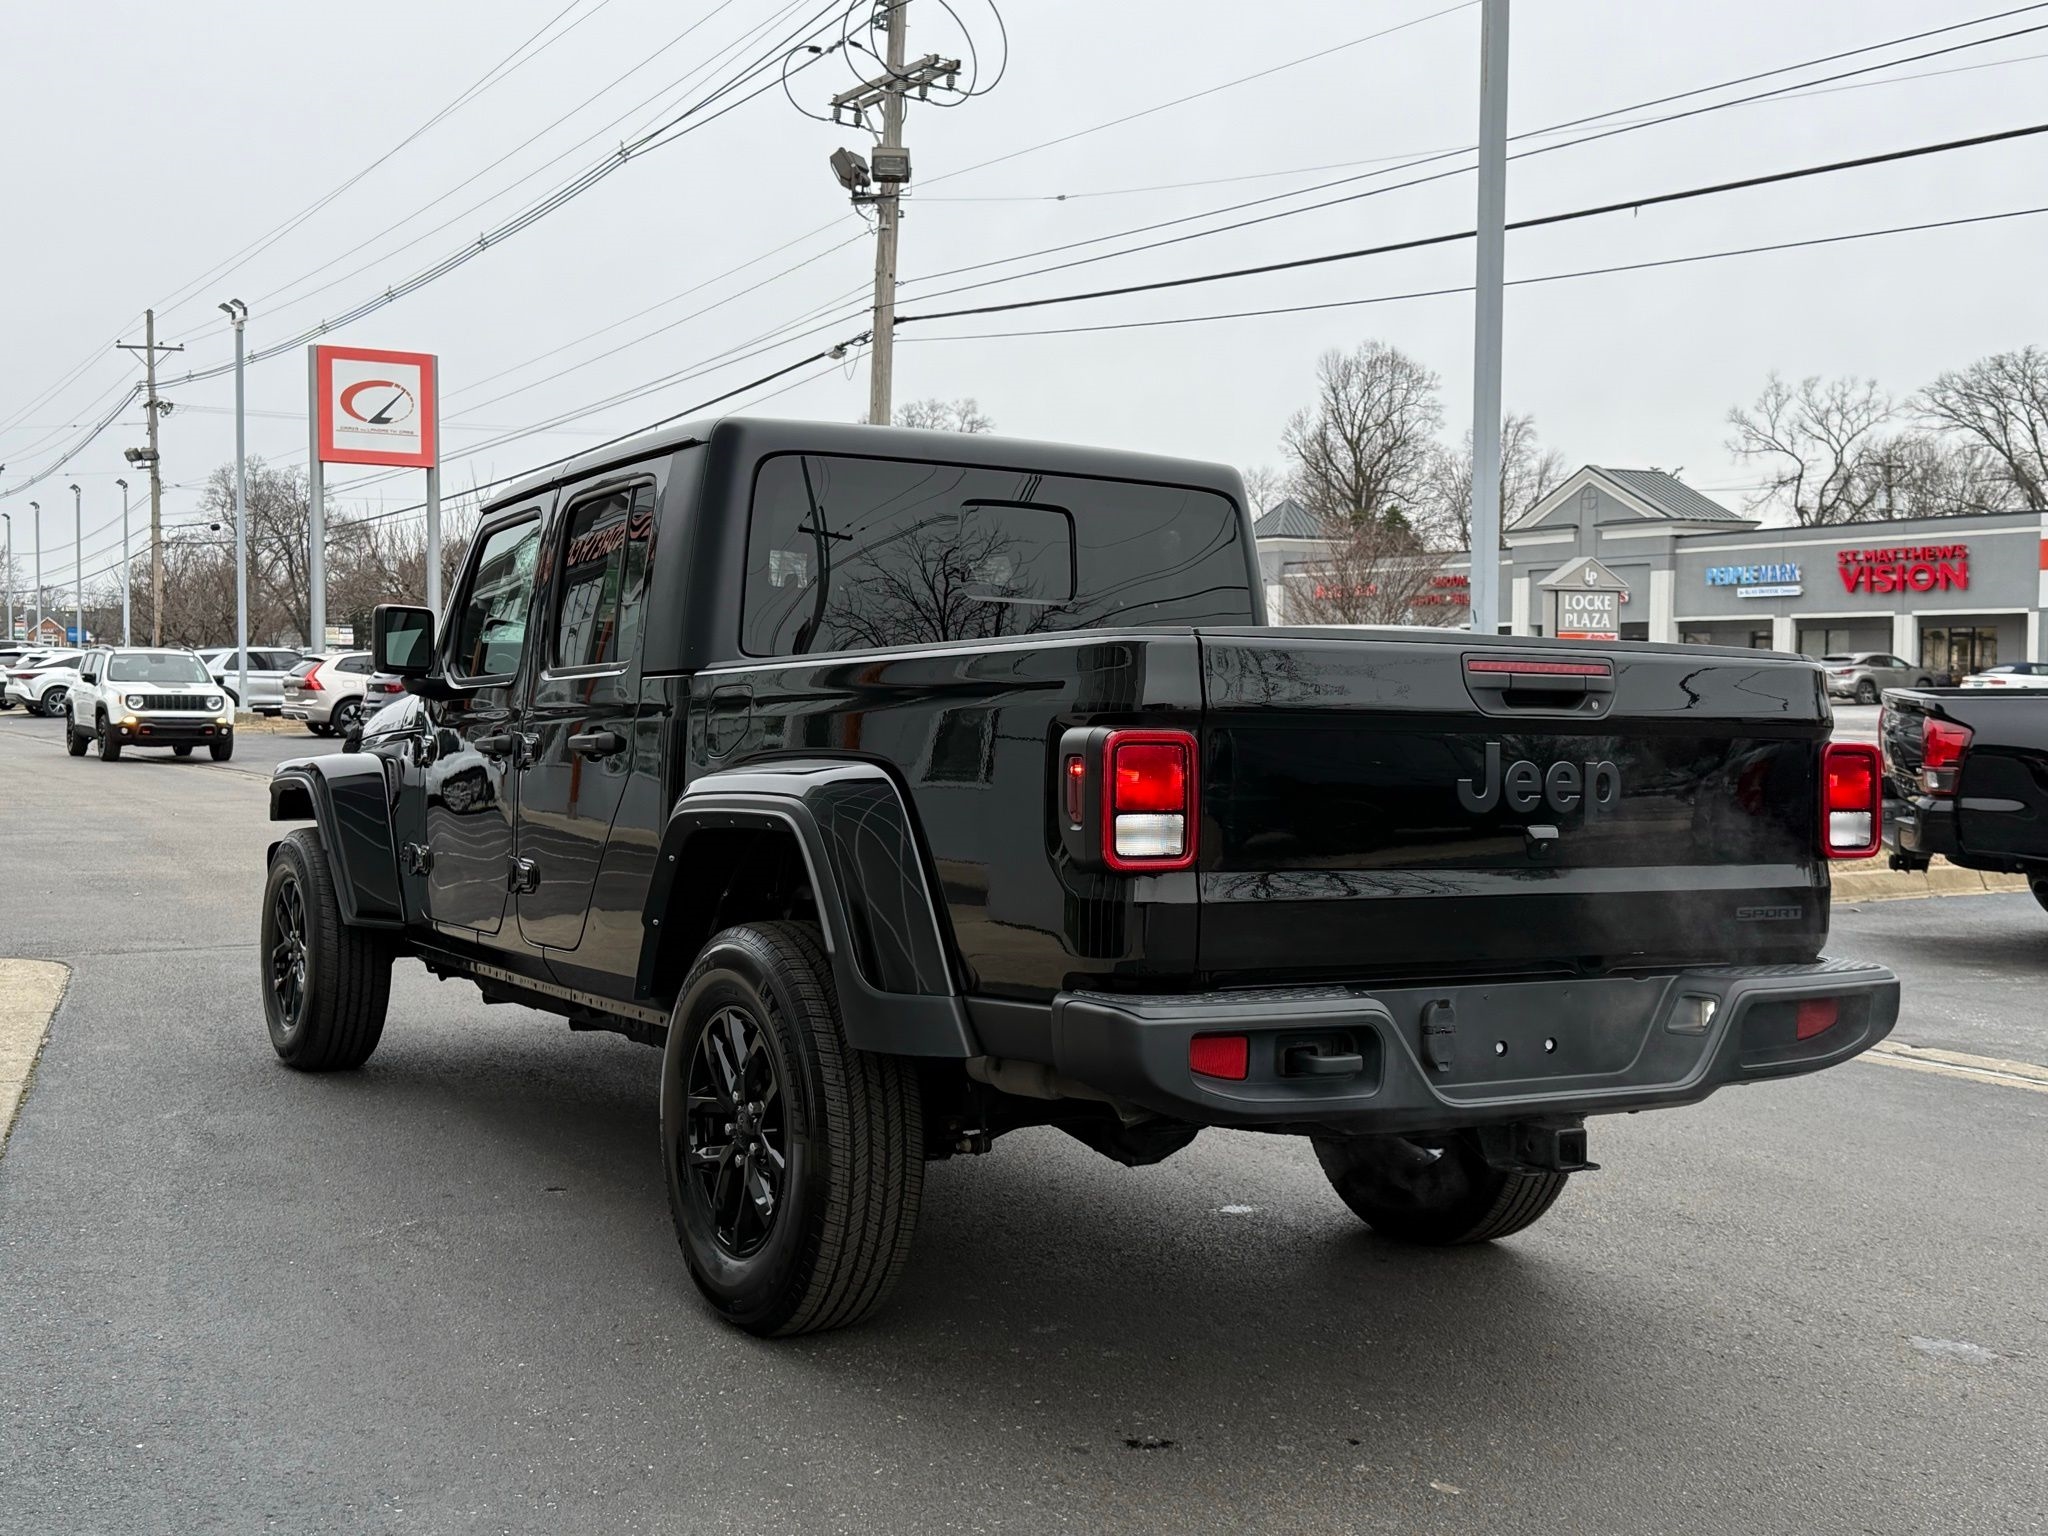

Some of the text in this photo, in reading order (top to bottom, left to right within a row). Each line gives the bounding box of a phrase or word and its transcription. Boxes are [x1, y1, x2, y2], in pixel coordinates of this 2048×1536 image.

[1863, 545, 1968, 563] MATTHEWS
[1705, 563, 1800, 585] PEOPLEMARK
[1839, 562, 1968, 593] VISION
[1565, 594, 1611, 611] LOCKE
[1565, 613, 1610, 628] PLAZA
[1457, 742, 1621, 825] Jeep
[1737, 907, 1802, 919] SPORT
